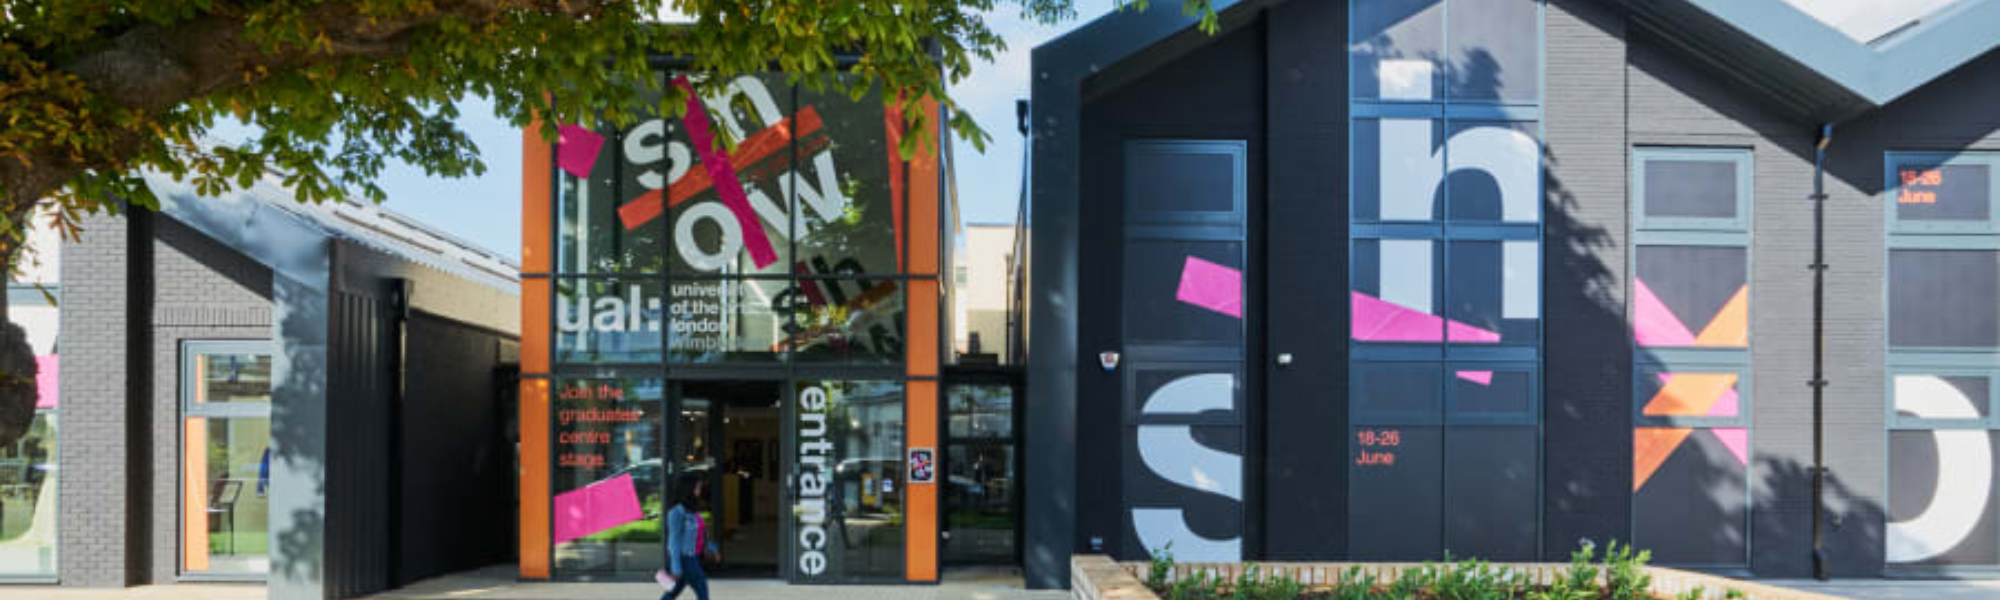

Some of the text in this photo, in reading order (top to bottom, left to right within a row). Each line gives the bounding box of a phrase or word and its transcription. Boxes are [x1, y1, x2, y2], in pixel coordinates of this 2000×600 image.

[557, 284, 661, 332] ual:
[671, 301, 689, 314] of
[692, 300, 719, 314] the
[597, 384, 623, 399] the
[1355, 449, 1394, 465] June
[800, 386, 835, 576] entrance
